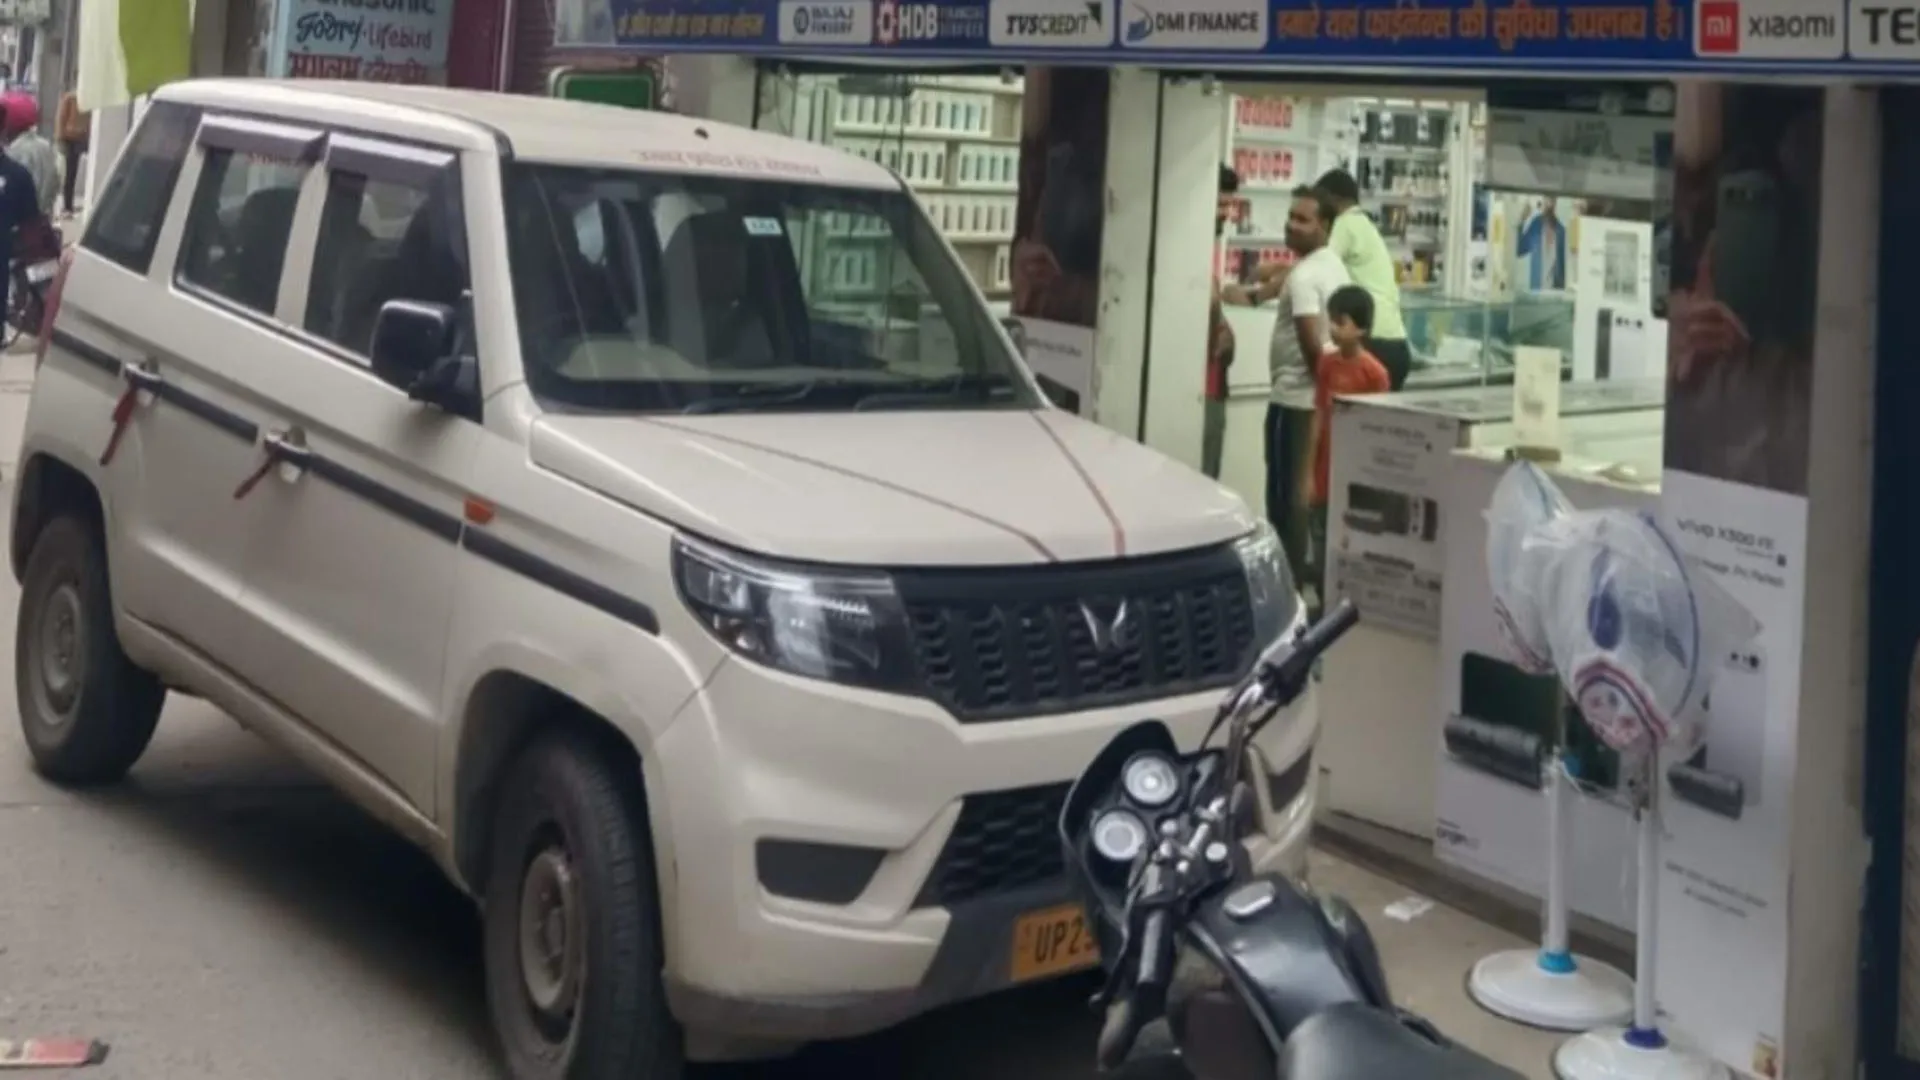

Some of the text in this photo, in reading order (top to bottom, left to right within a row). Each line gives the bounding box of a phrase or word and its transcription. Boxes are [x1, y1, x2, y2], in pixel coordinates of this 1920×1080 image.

[899, 3, 938, 39] HDB
[1155, 12, 1259, 33] DMI FINANCE
[1861, 8, 1920, 45] TE
